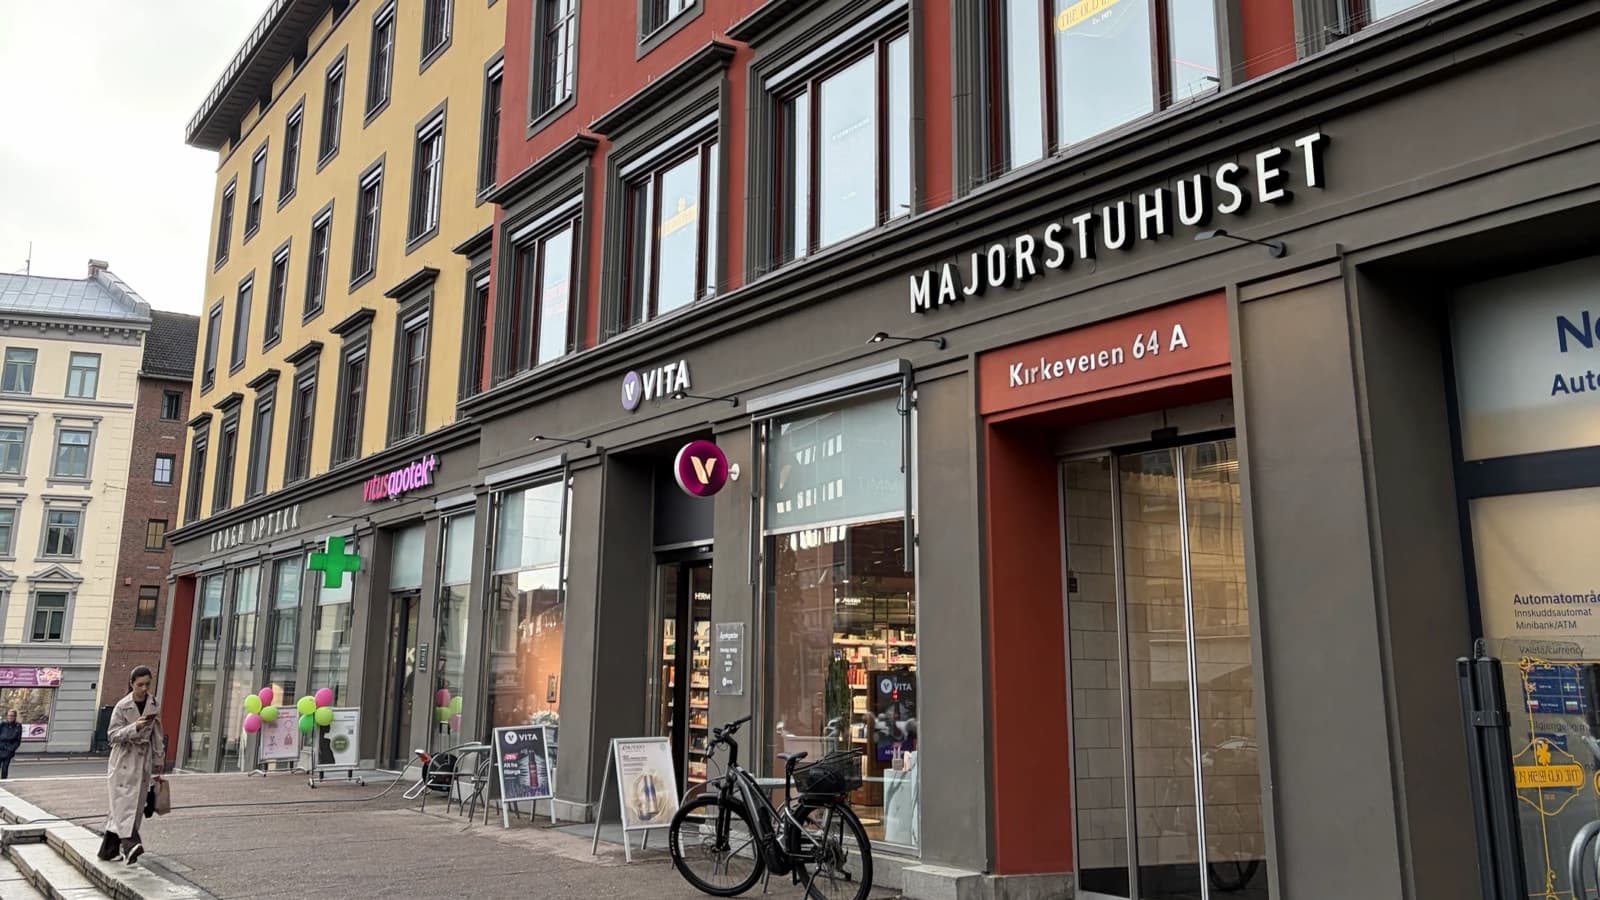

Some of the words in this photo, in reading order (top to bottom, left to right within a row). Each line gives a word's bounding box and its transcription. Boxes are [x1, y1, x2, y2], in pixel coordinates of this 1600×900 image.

[909, 132, 1322, 314] MAJORSTUHUSET
[1556, 310, 1600, 353] N
[1009, 346, 1124, 387] Kirkeveien
[1132, 330, 1160, 360] 64
[1169, 323, 1189, 351] A
[642, 359, 691, 401] VITA
[210, 523, 245, 553] KROGH
[251, 503, 299, 541] OPTIKK
[1514, 607, 1592, 618] Innskuddsautomat
[1516, 620, 1577, 630] Minibank/ATM
[894, 682, 912, 691] VITA
[518, 733, 538, 741] VITA
